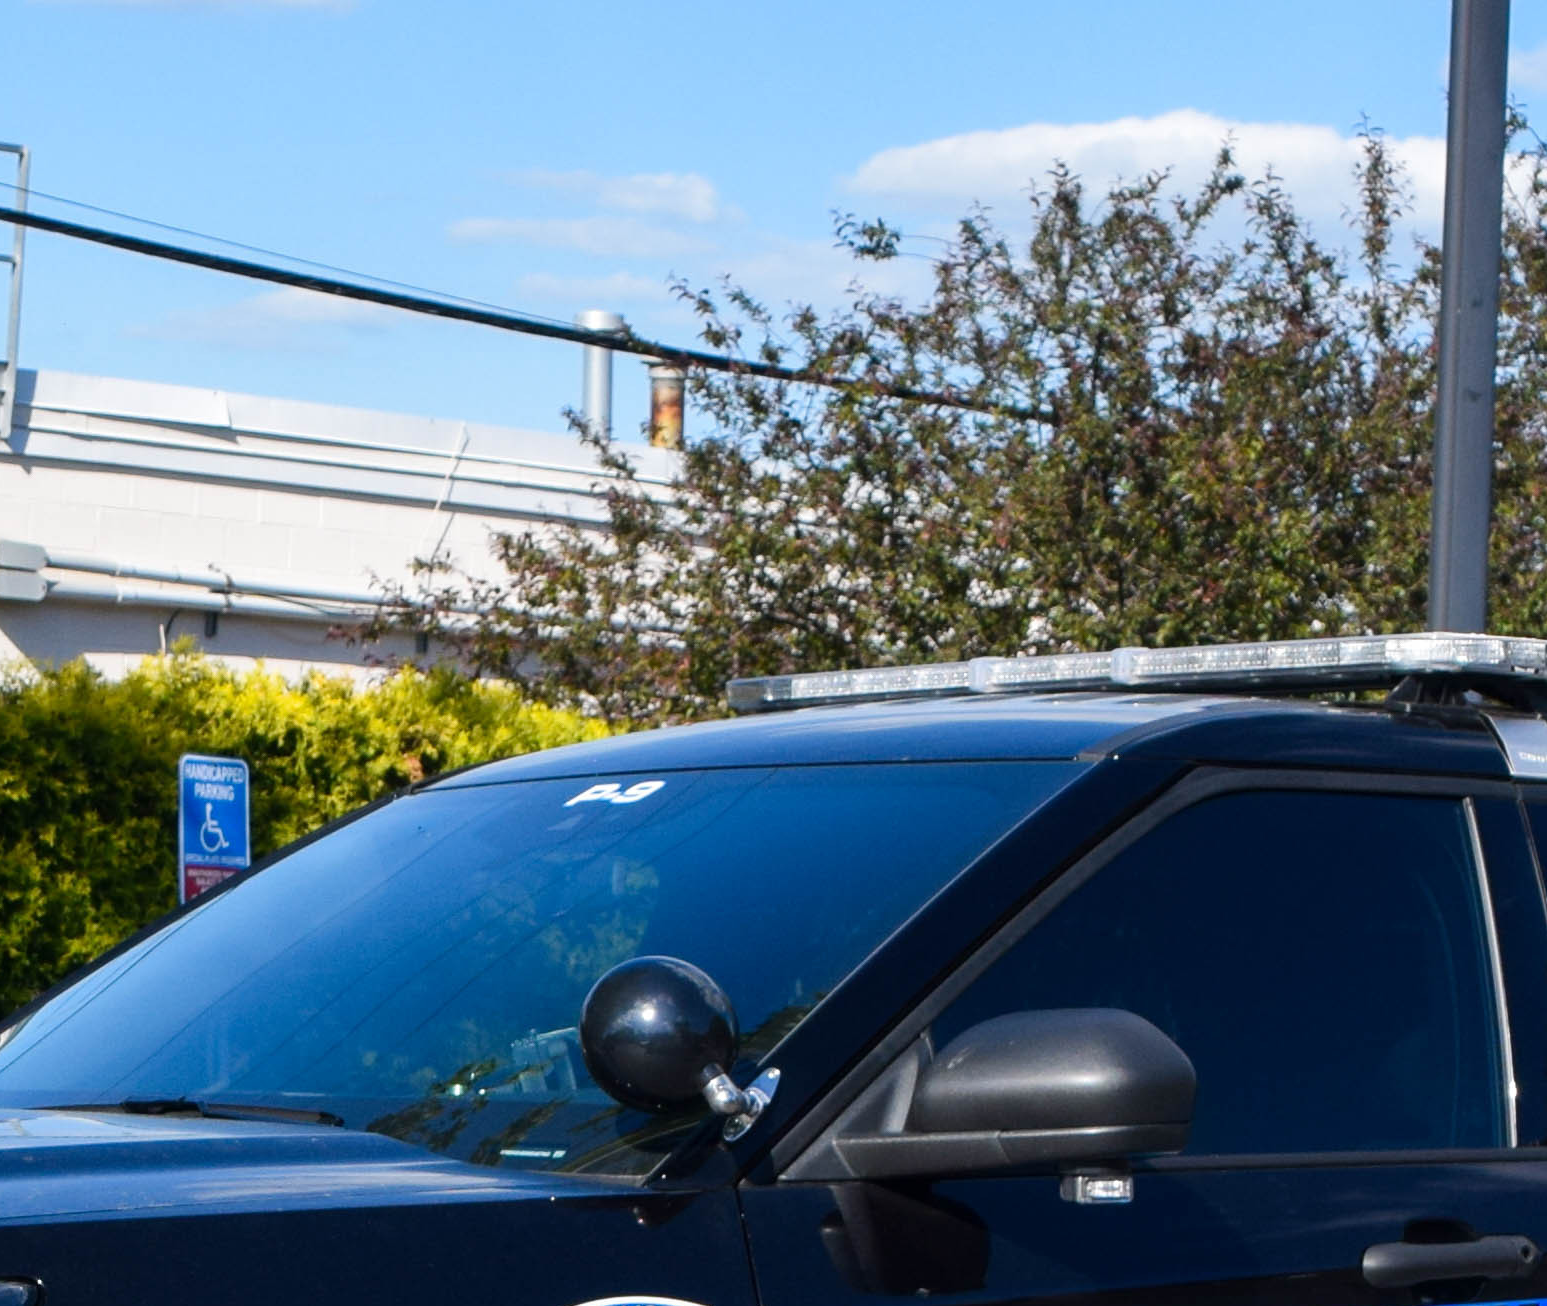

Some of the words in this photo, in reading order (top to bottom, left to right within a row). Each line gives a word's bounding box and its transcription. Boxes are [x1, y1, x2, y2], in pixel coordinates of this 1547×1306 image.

[185, 763, 244, 784] HANDICAPPED
[194, 782, 235, 801] PARKING
[563, 780, 666, 807] P-9
